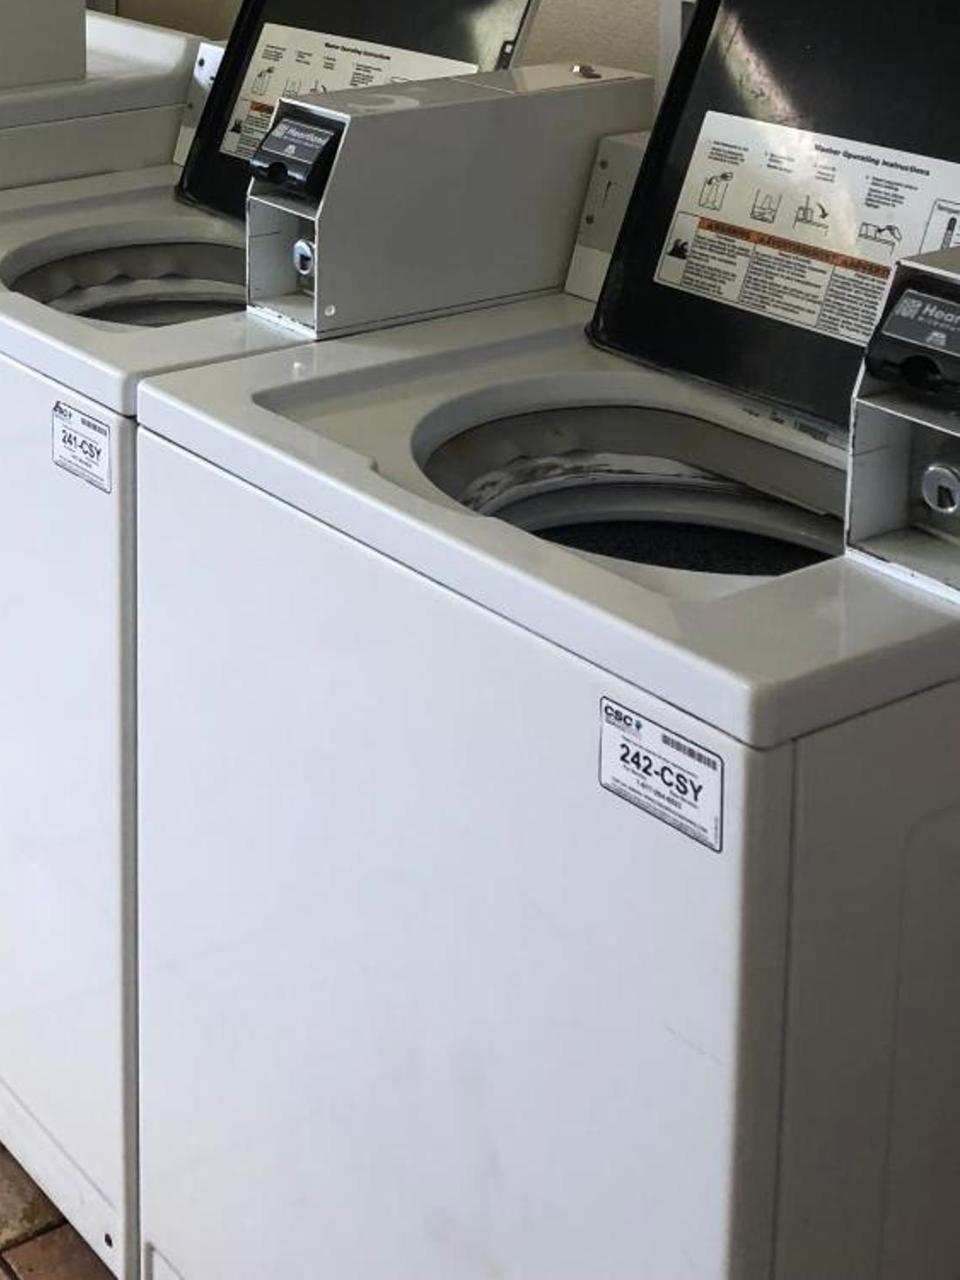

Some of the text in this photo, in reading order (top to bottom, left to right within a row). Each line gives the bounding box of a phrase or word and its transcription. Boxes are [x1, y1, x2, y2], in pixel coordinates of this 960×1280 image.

[814, 144, 930, 177] Washer Operating Instructions
[61, 428, 102, 461] 241-CSY
[604, 705, 634, 727] CSC
[620, 743, 703, 801] 242-CSY
